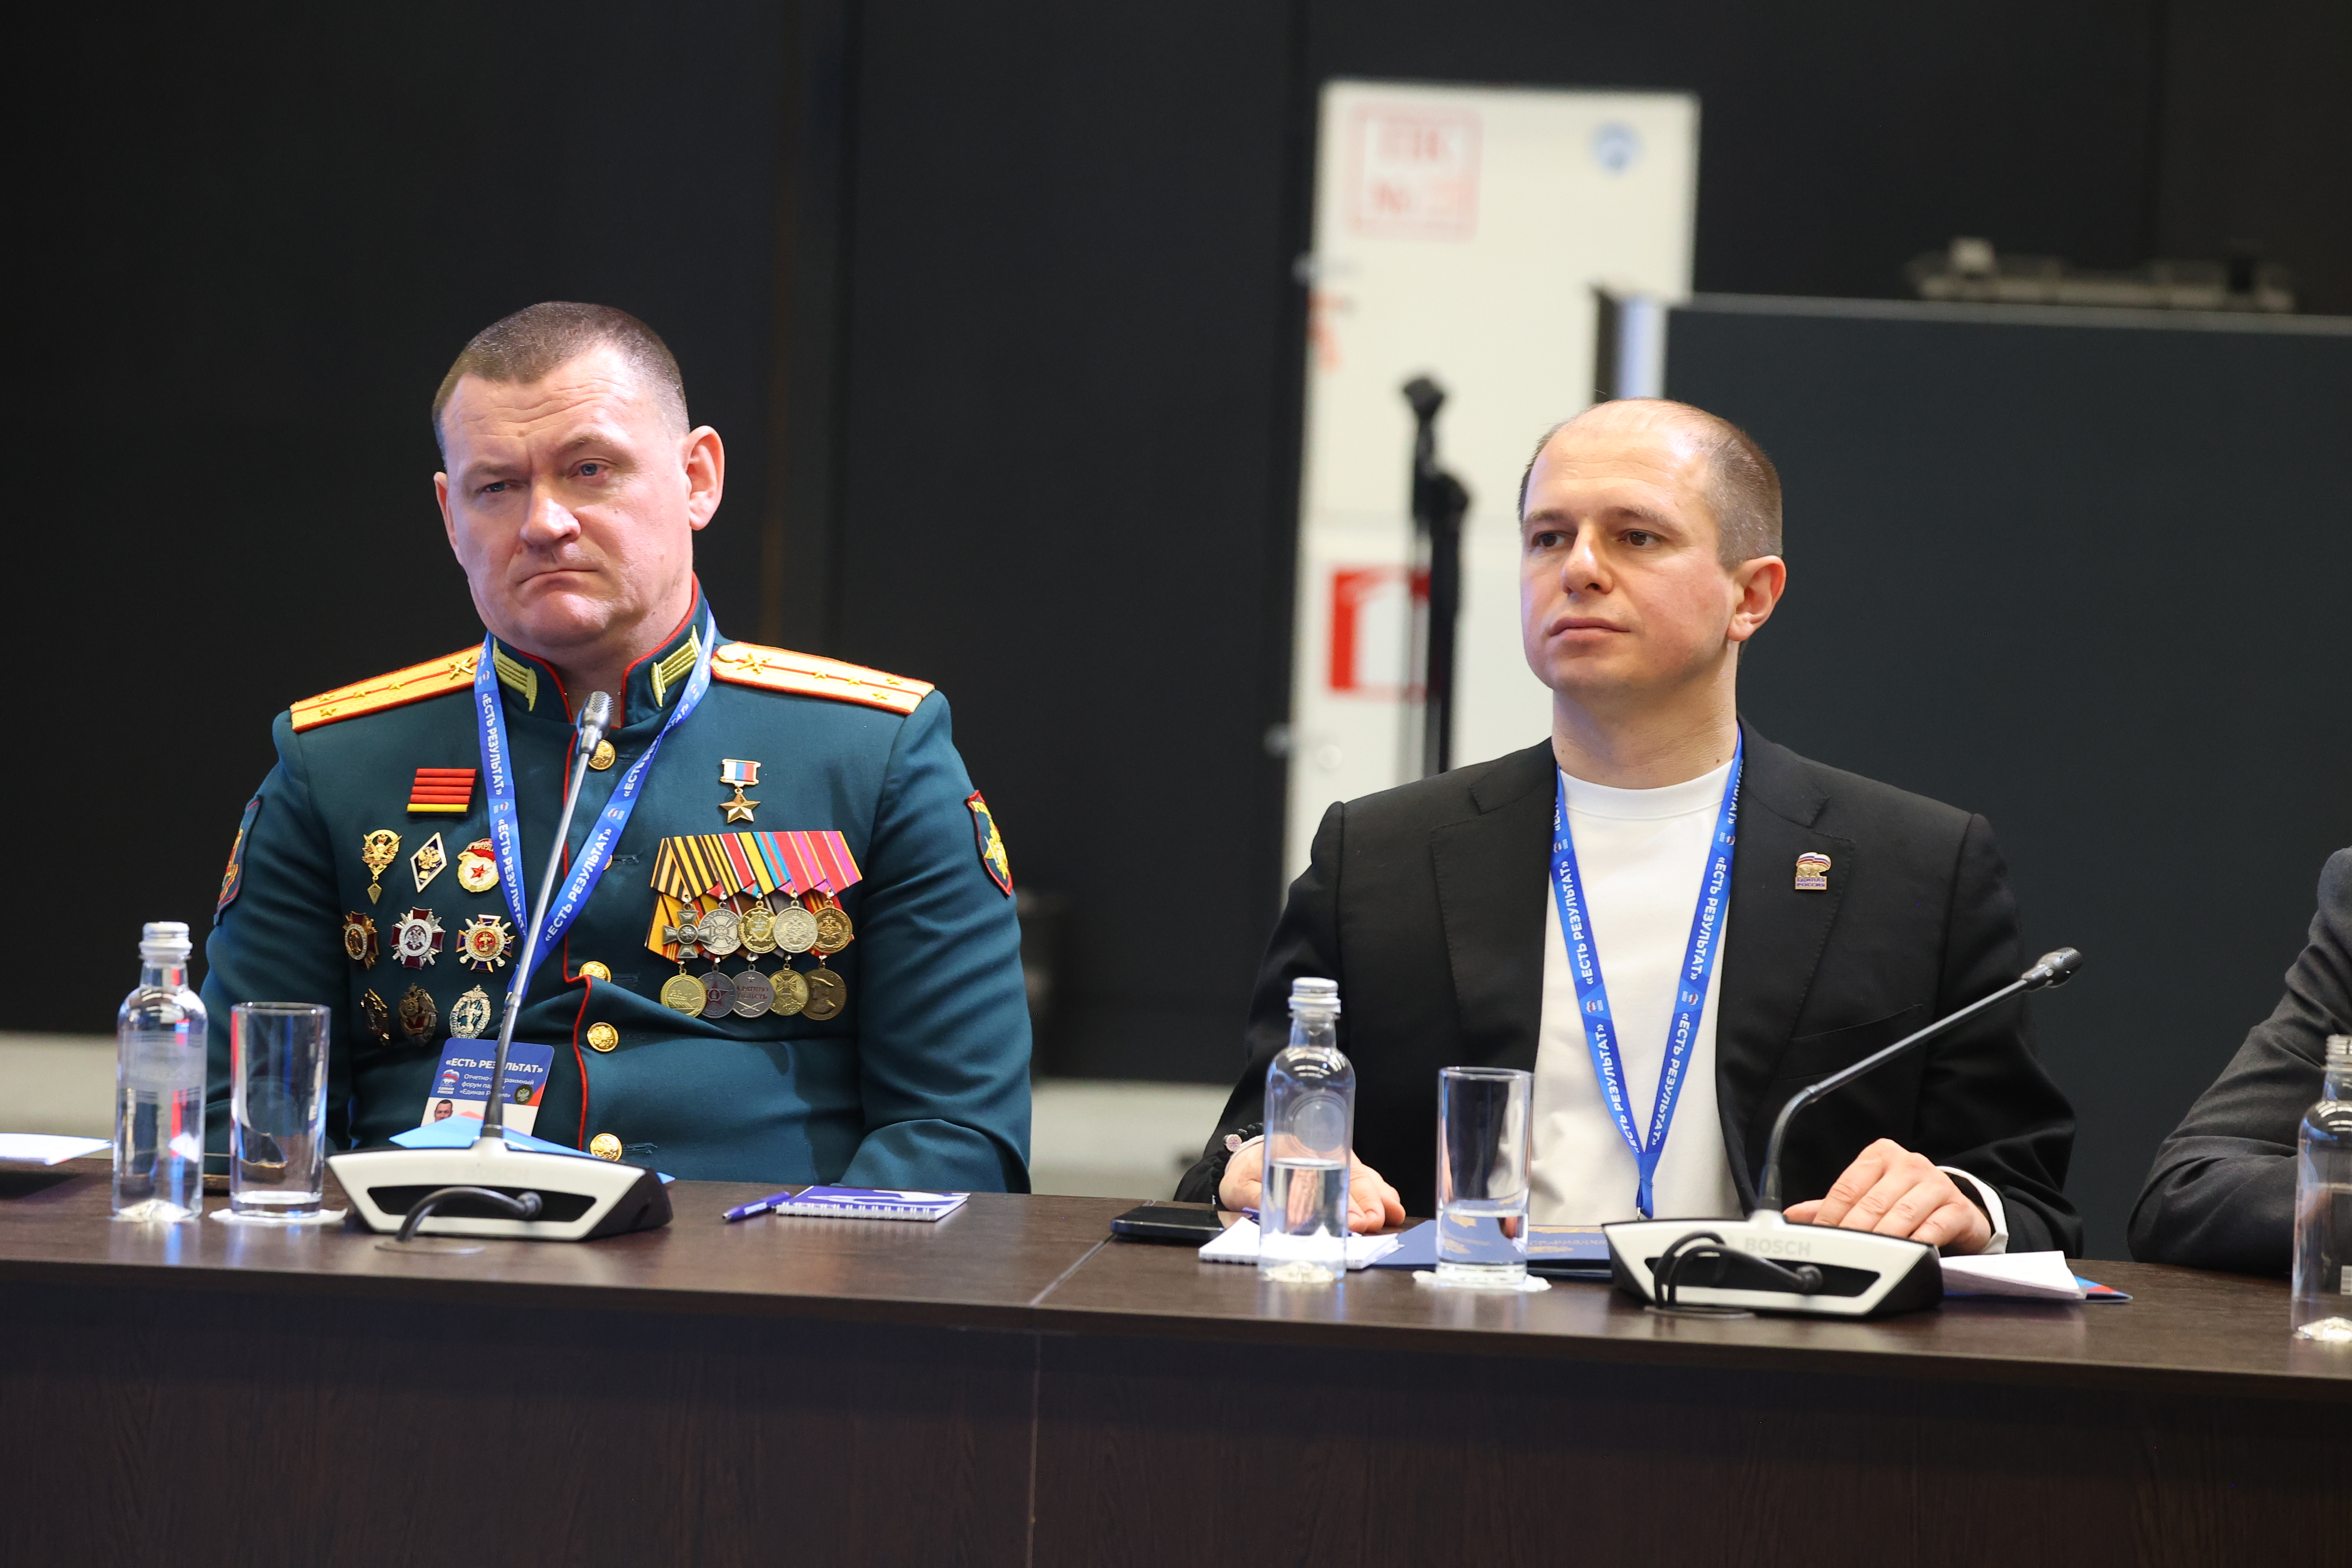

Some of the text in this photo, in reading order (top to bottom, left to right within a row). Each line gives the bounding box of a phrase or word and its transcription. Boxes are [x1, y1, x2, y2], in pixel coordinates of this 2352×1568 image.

[482, 693, 505, 795] «ЕСТЬ РЕЗУЛЬТАТ»
[623, 762, 646, 797] «ЕСТЬ
[498, 819, 526, 936] «ЕСТЬ РЕЗУЛЬТАТ»
[545, 828, 612, 941] «ЕСТЬ РЕЗУЛЬТАТ»
[1559, 861, 1594, 985] «ЕСТЬ РЕЗУЛЬТАТ»
[1690, 857, 1727, 980] «ЕСТЬ РЕЗУЛЬТАТ»
[445, 1058, 477, 1068] «ЕСТЬ
[1595, 1024, 1640, 1154] «ЕСТЬ РЕЗУЛЬТАТ»
[1651, 1013, 1690, 1146] «ЕСТЬ РЕЗУЛЬТАТ»
[1745, 1237, 1812, 1256] BOSCH
